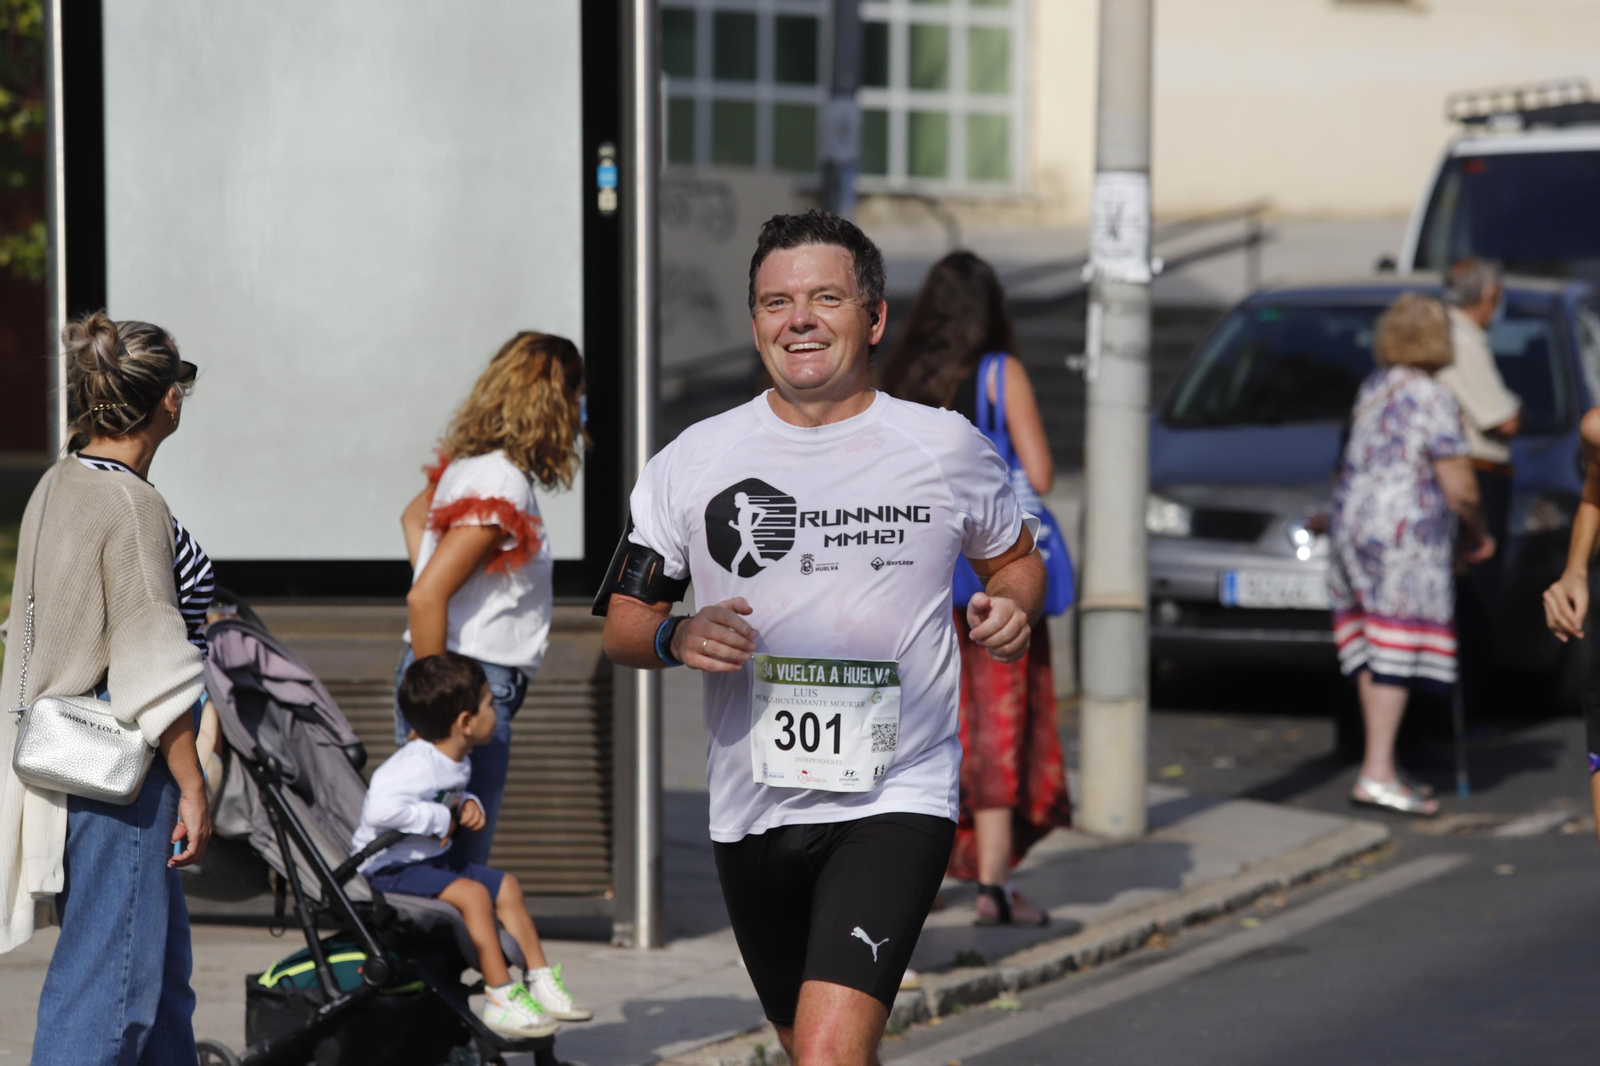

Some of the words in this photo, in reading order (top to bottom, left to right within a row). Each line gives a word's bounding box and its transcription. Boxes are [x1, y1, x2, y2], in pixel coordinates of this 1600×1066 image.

[799, 505, 931, 528] RUNNING
[824, 529, 905, 548] MMH21
[762, 662, 773, 680] 34
[776, 663, 826, 683] VUELTA
[829, 665, 840, 684] A
[843, 666, 891, 685] HUELVA
[793, 688, 818, 698] LUIS
[830, 701, 866, 709] MOURIER
[97, 724, 121, 736] LOLA
[774, 710, 842, 755] 301
[795, 756, 843, 767] INDEPENDIENTE
